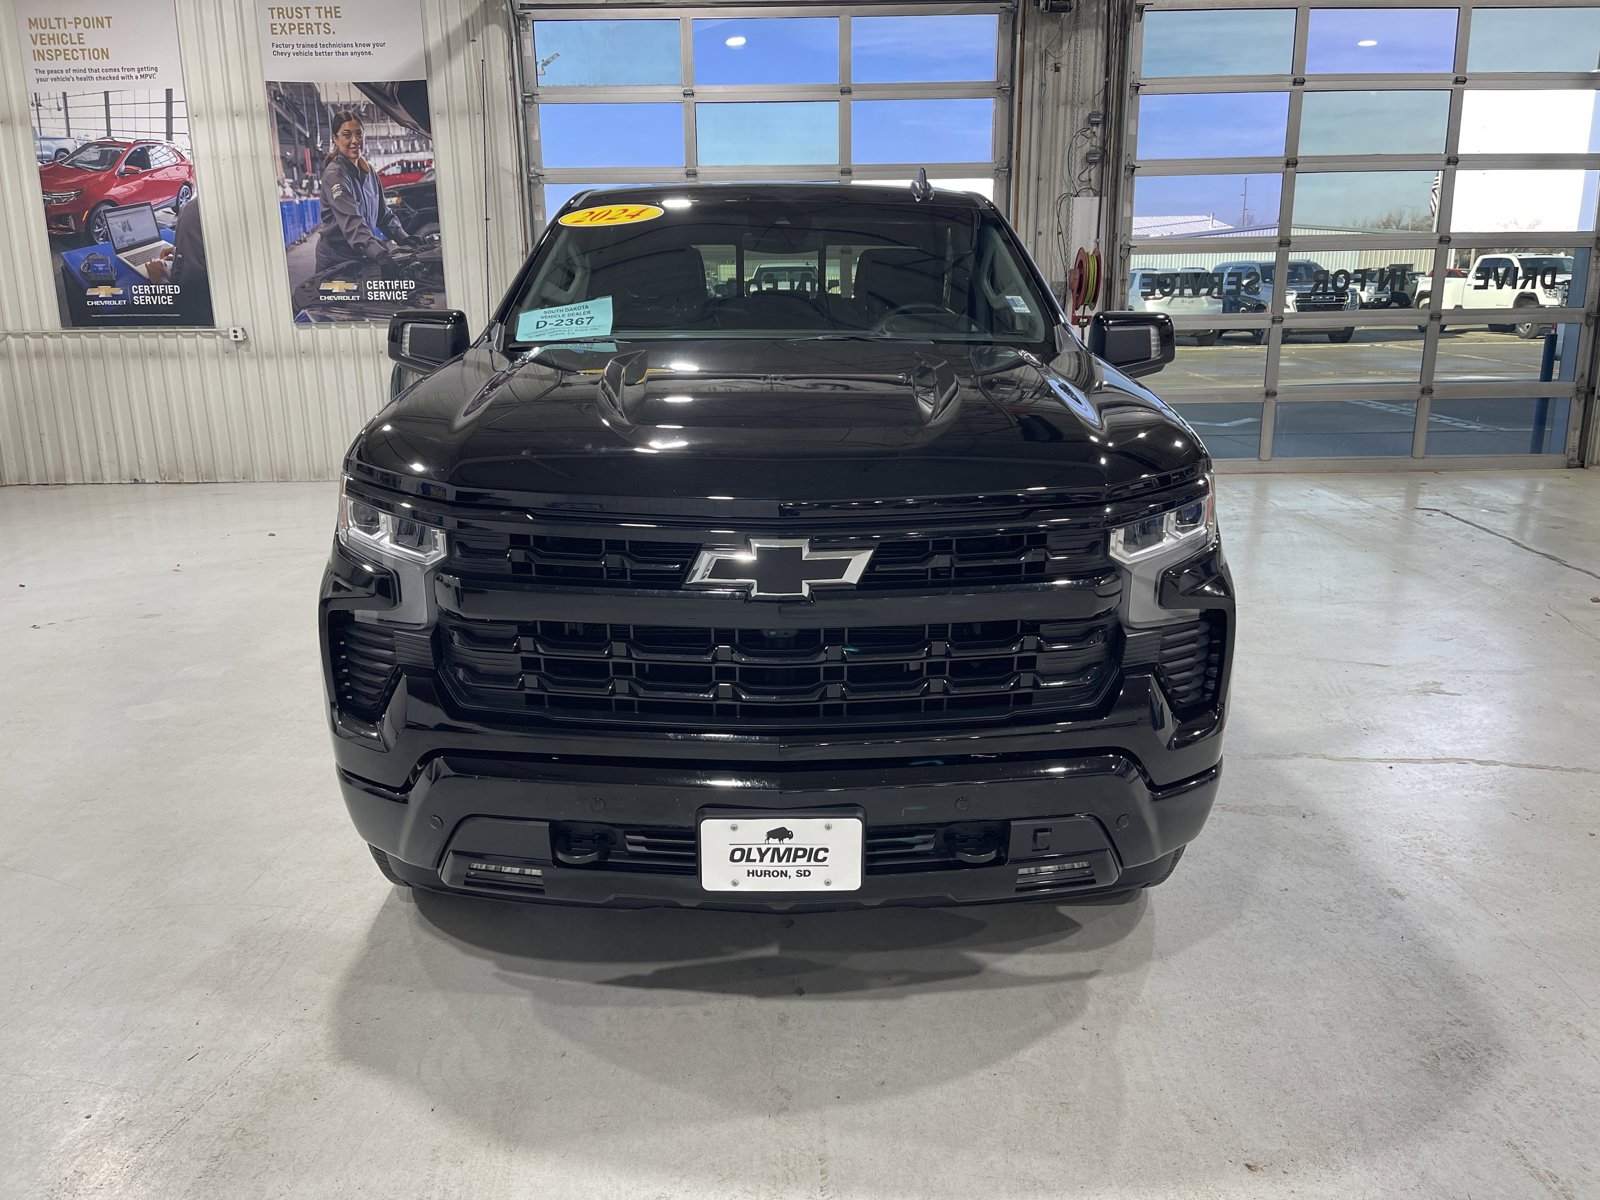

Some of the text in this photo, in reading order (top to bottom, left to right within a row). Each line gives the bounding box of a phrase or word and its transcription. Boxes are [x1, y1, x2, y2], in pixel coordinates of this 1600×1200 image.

[268, 6, 342, 19] TRUST THE
[28, 16, 112, 30] MULTI-POINT
[270, 22, 336, 35] EXPERTS.
[30, 33, 85, 46] VEHICLE
[32, 48, 110, 61] INSPECTION
[572, 208, 650, 223] 2024
[132, 285, 180, 294] CERTIFIED
[366, 280, 415, 290] CERTIFIED
[133, 296, 173, 305] SERVICE
[367, 291, 408, 300] SERVICE
[536, 316, 595, 330] D-2367
[729, 847, 829, 863] OLYMPIC
[747, 869, 811, 880] HURON, SD
